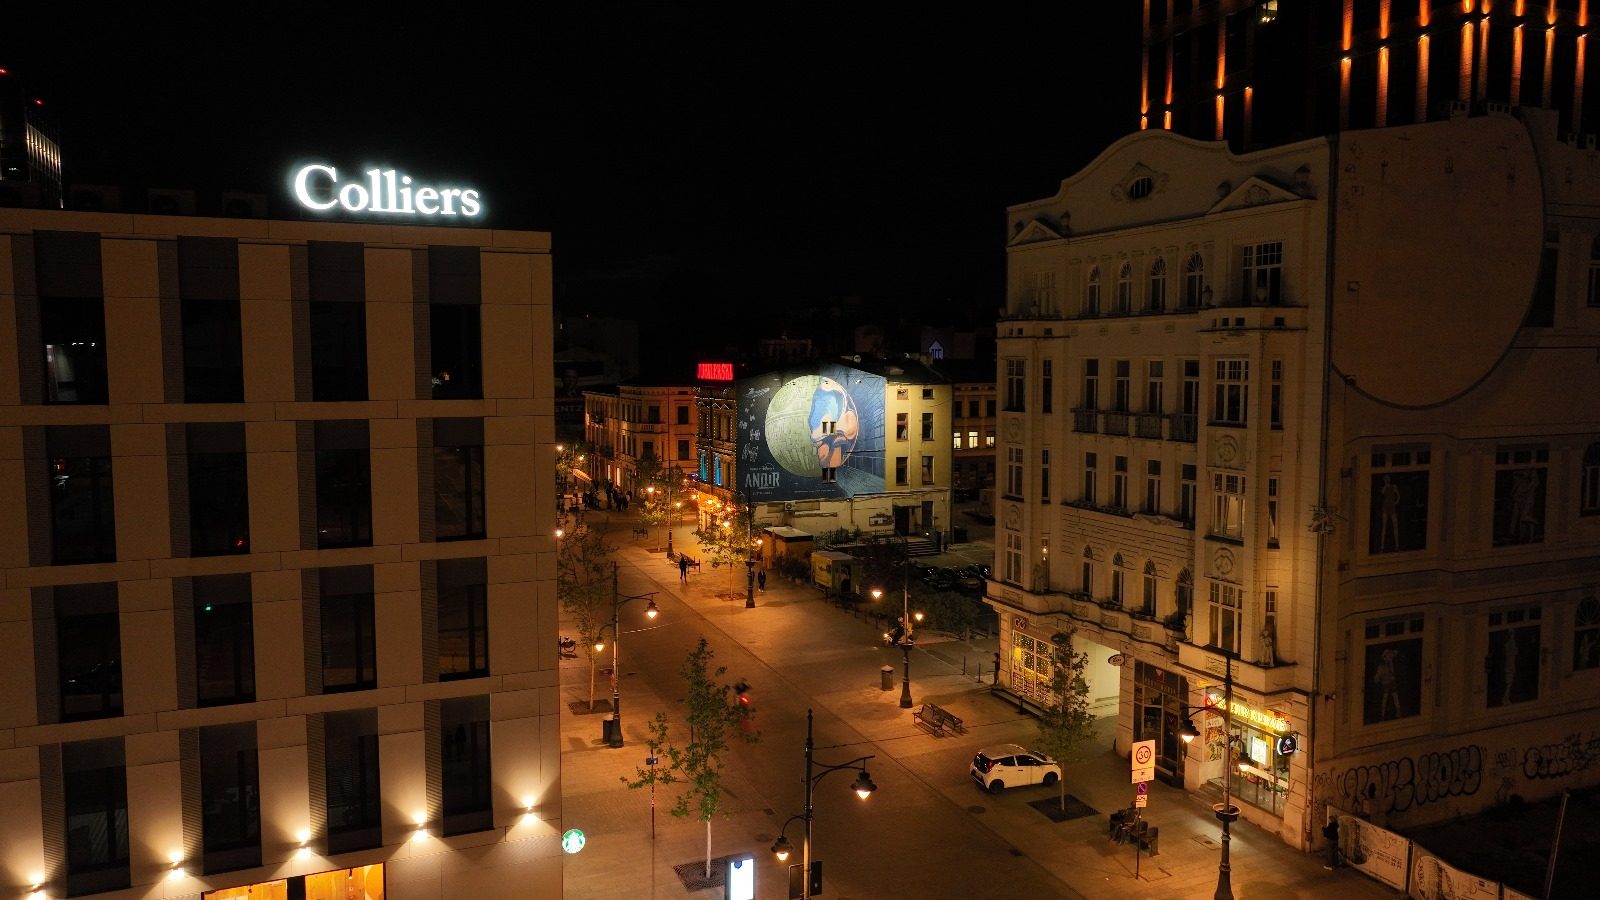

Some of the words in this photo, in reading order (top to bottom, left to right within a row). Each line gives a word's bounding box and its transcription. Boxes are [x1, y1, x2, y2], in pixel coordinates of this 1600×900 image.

[295, 164, 480, 216] Colliers
[744, 471, 780, 488] ANDOR
[1138, 750, 1150, 760] 30
